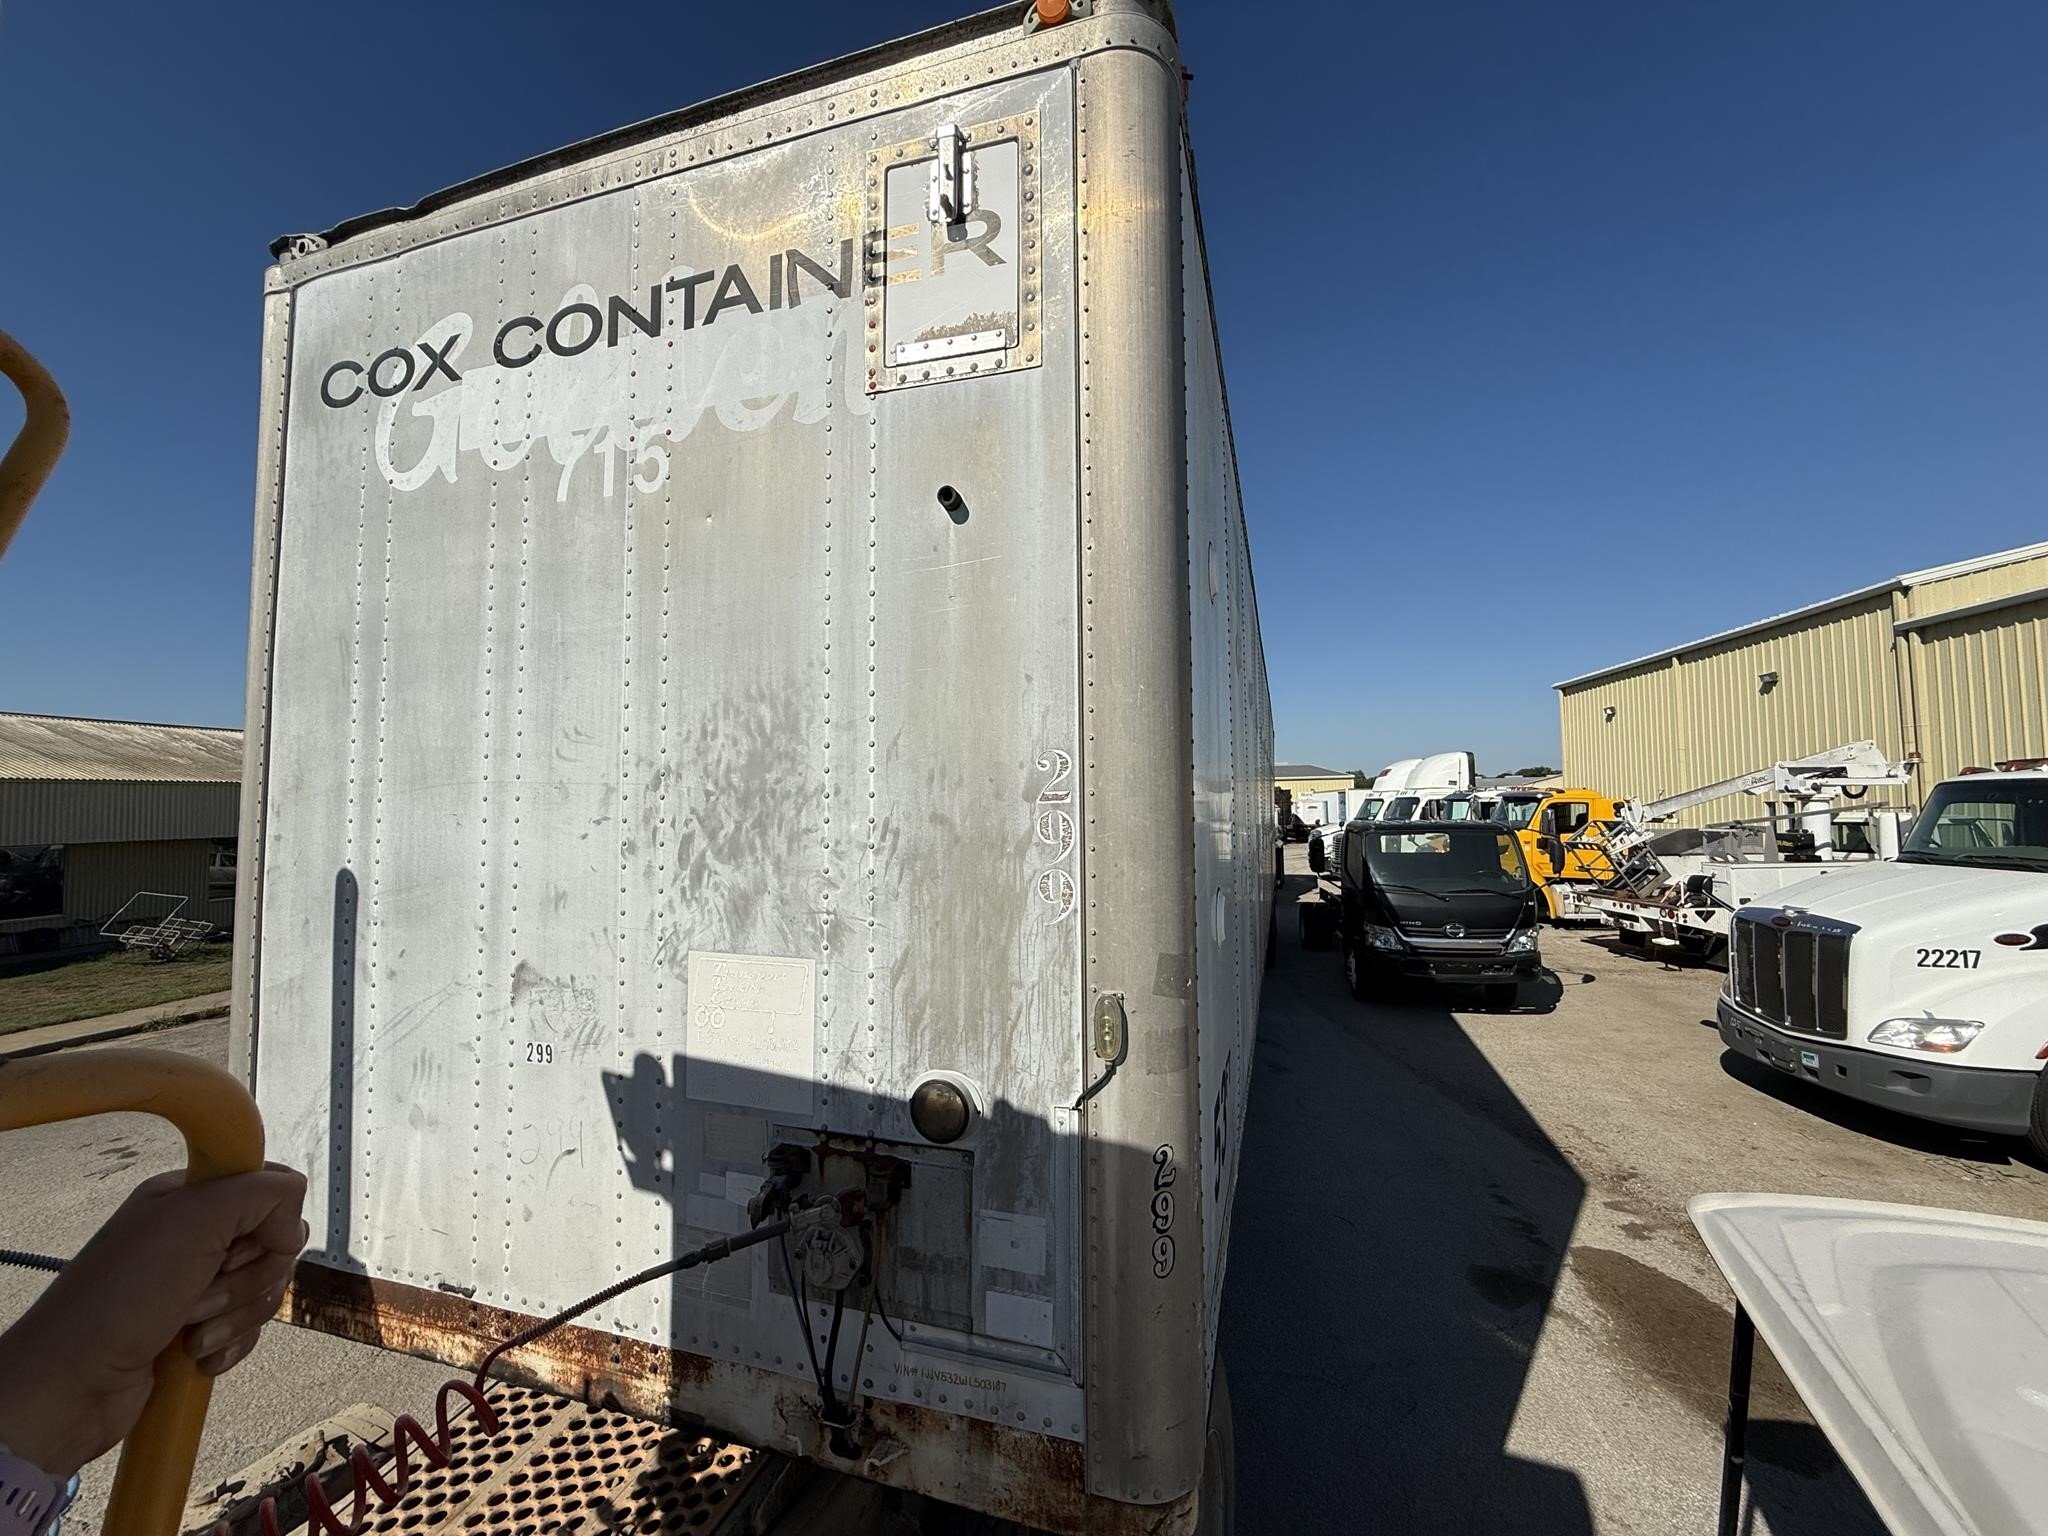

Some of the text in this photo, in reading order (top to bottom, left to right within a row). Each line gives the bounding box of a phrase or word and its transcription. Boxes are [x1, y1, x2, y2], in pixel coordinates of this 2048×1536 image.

[320, 208, 1007, 409] COX CONTAINER
[1036, 749, 1076, 926] 299
[1916, 948, 1982, 969] 22217
[526, 1042, 553, 1063] 299
[1151, 1143, 1177, 1279] 299
